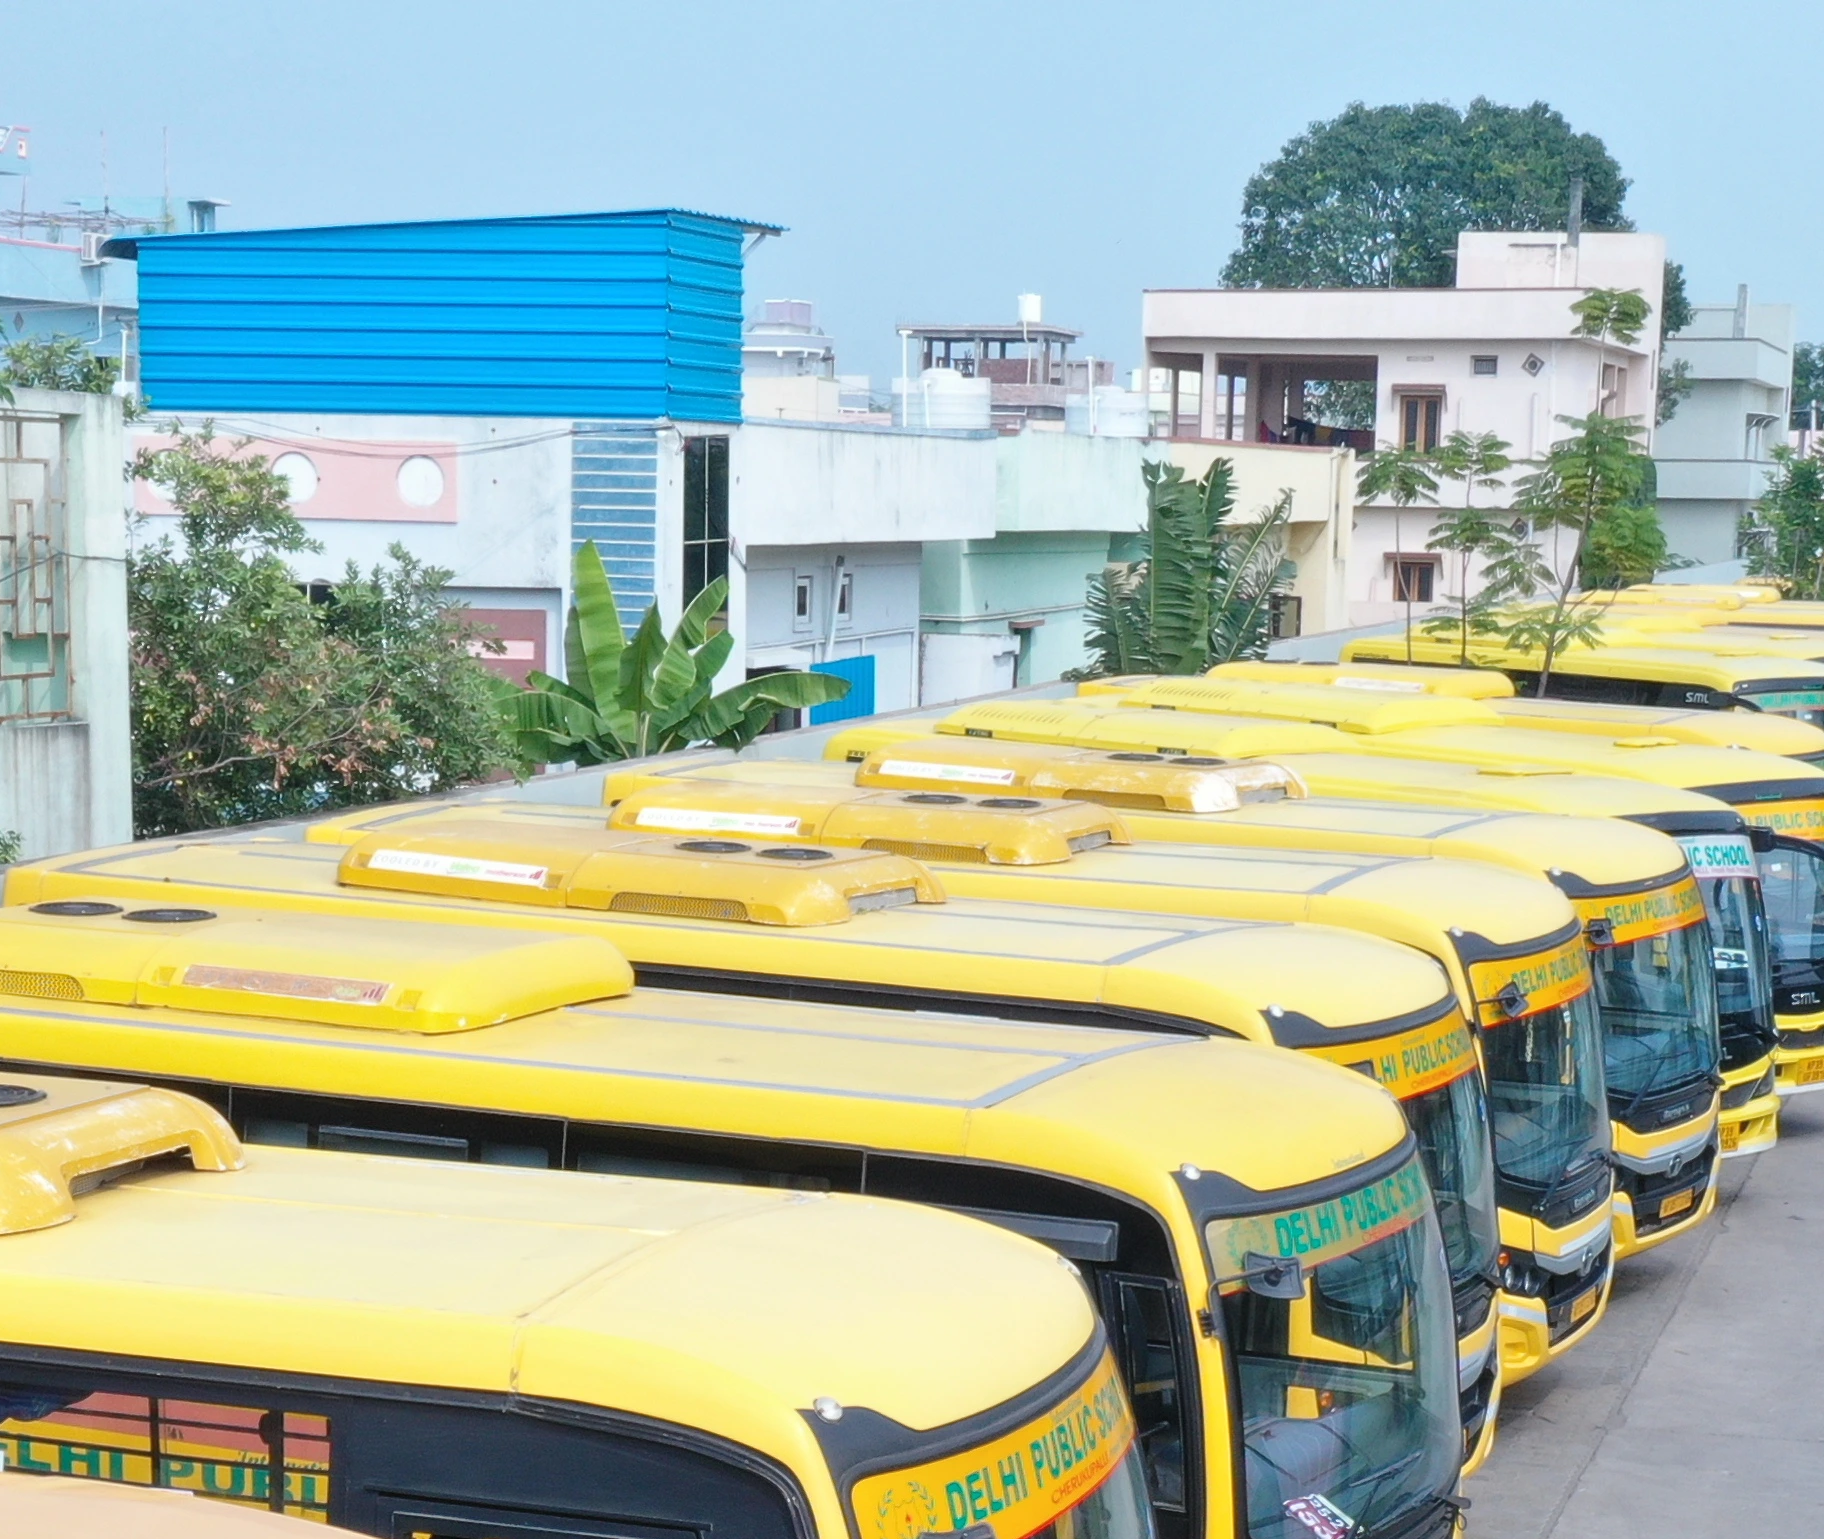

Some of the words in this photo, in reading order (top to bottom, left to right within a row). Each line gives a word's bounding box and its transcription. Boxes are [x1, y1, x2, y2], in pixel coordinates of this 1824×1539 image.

[1706, 845, 1750, 866] SCHOOL
[1274, 1203, 1341, 1258] DELHI
[944, 1452, 1029, 1531] DELHI
[1029, 1404, 1097, 1488] PUBLIC
